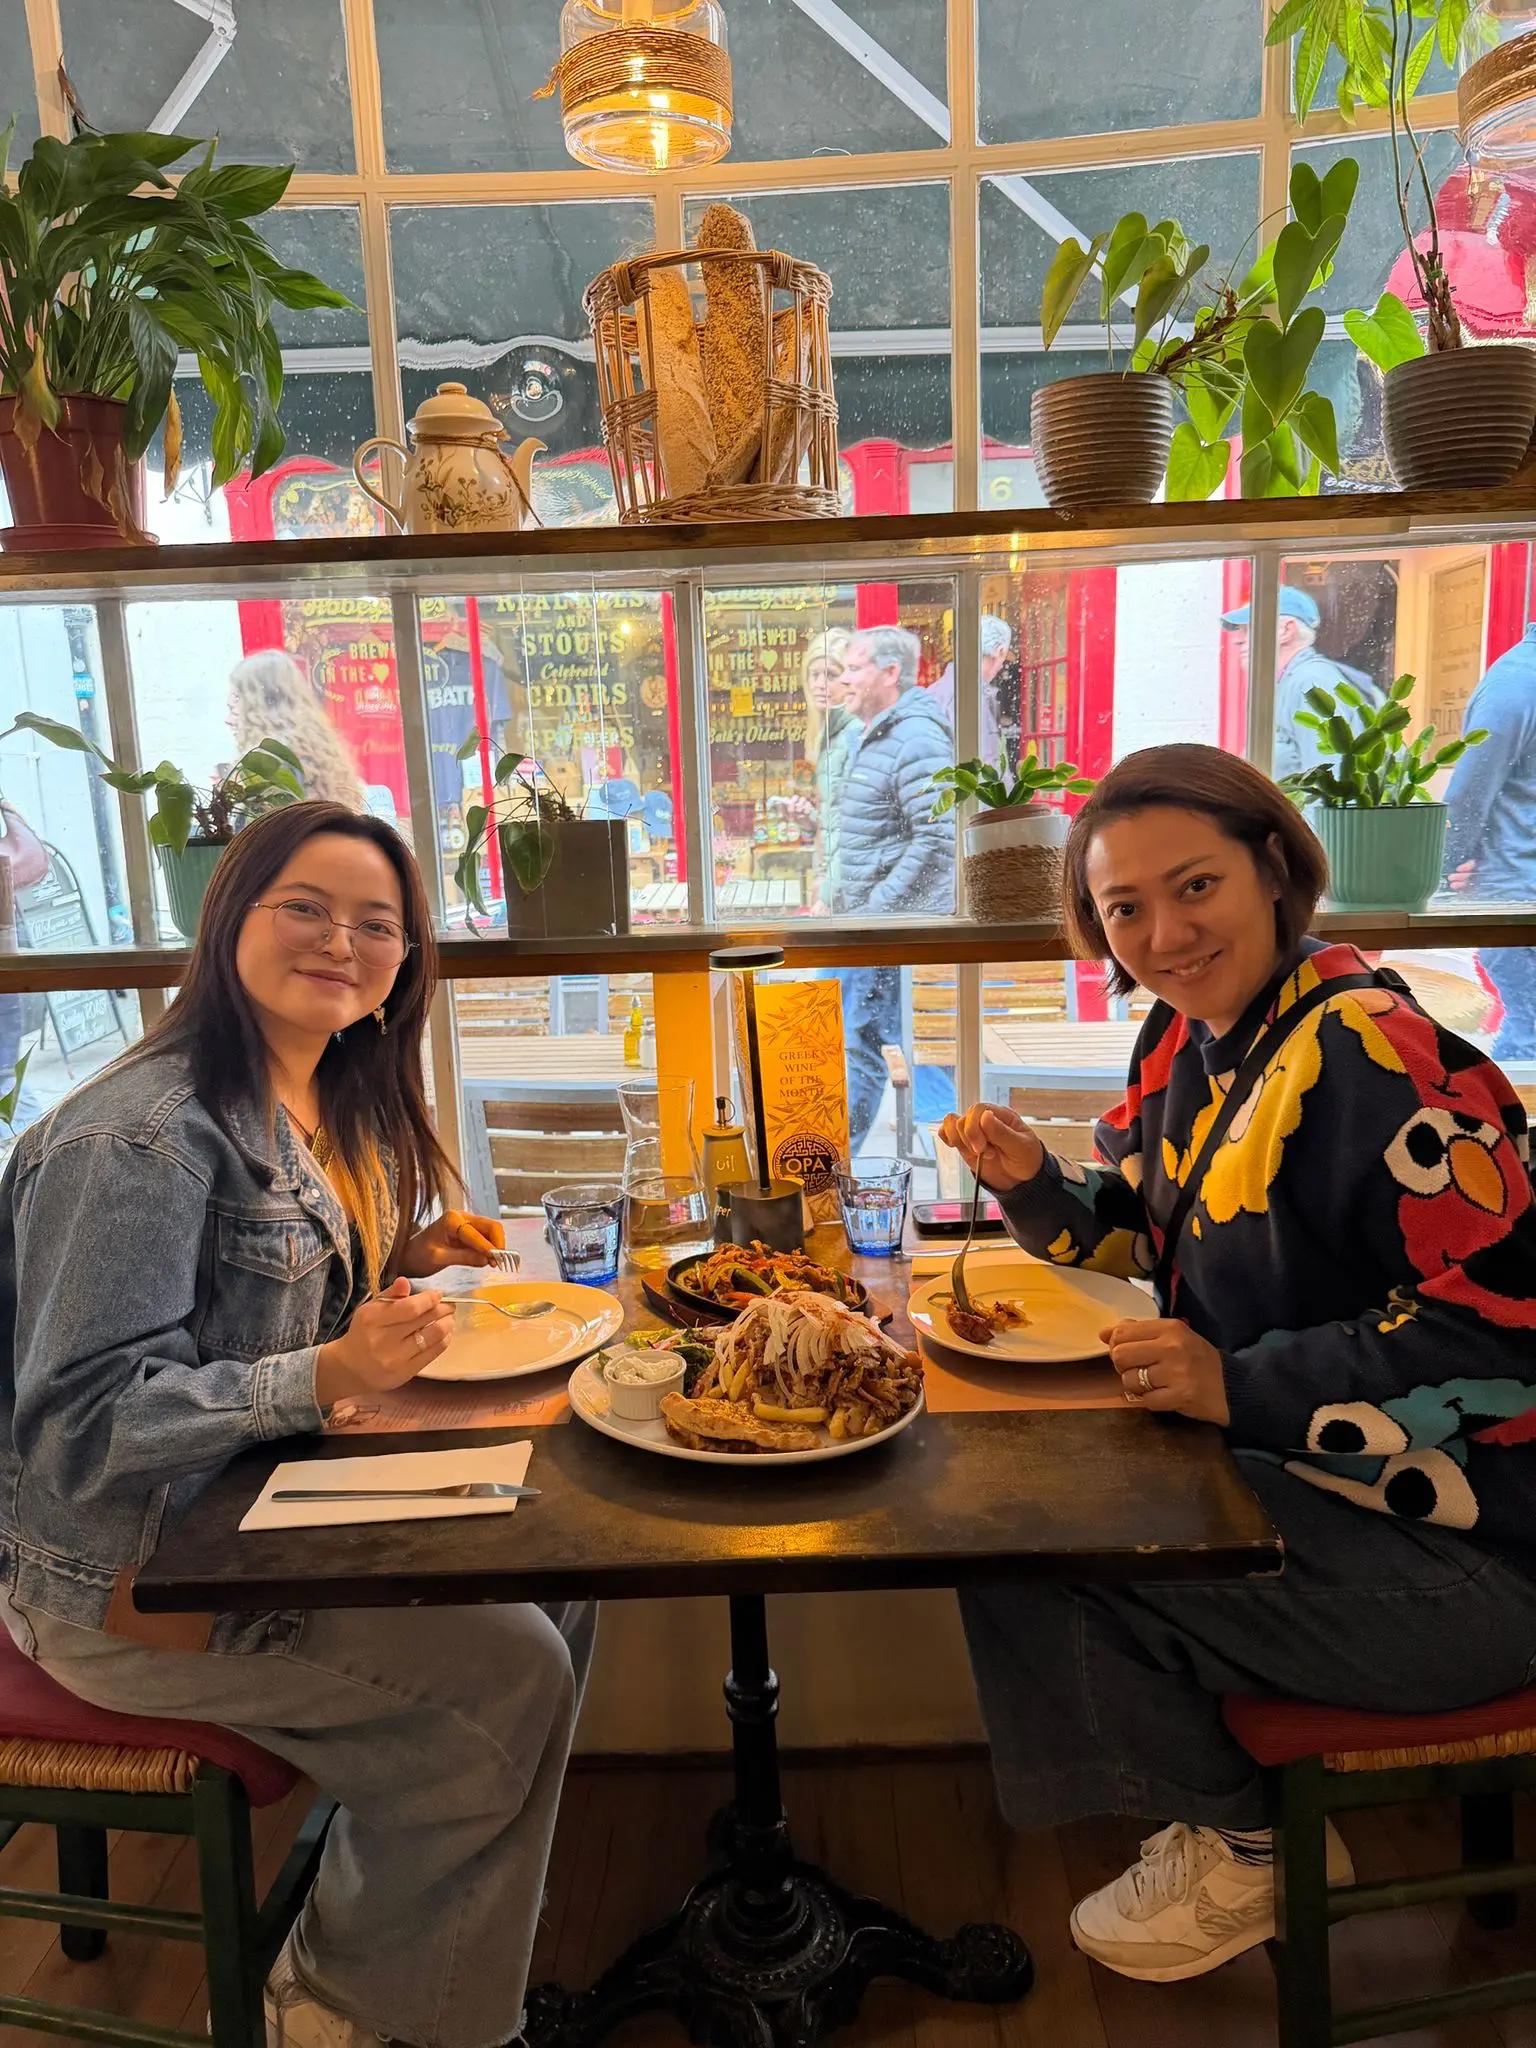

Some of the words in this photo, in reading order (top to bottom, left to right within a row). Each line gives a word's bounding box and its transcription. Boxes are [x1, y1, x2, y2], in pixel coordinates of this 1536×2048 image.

[989, 475, 1013, 502] 6
[556, 615, 587, 629] AND
[521, 631, 625, 657] STOUTS
[738, 628, 797, 646] BREWED
[730, 652, 754, 670] THE
[341, 666, 367, 683] THE
[763, 673, 797, 692] BATH
[529, 682, 627, 708] CIDERS
[746, 725, 785, 743] Oldest
[778, 1051, 820, 1061] GREEK
[784, 1062, 817, 1073] WINE
[779, 1075, 795, 1086] OF
[799, 1074, 822, 1086] THE
[779, 1088, 825, 1099] MONTH
[785, 1156, 827, 1174] OPA
